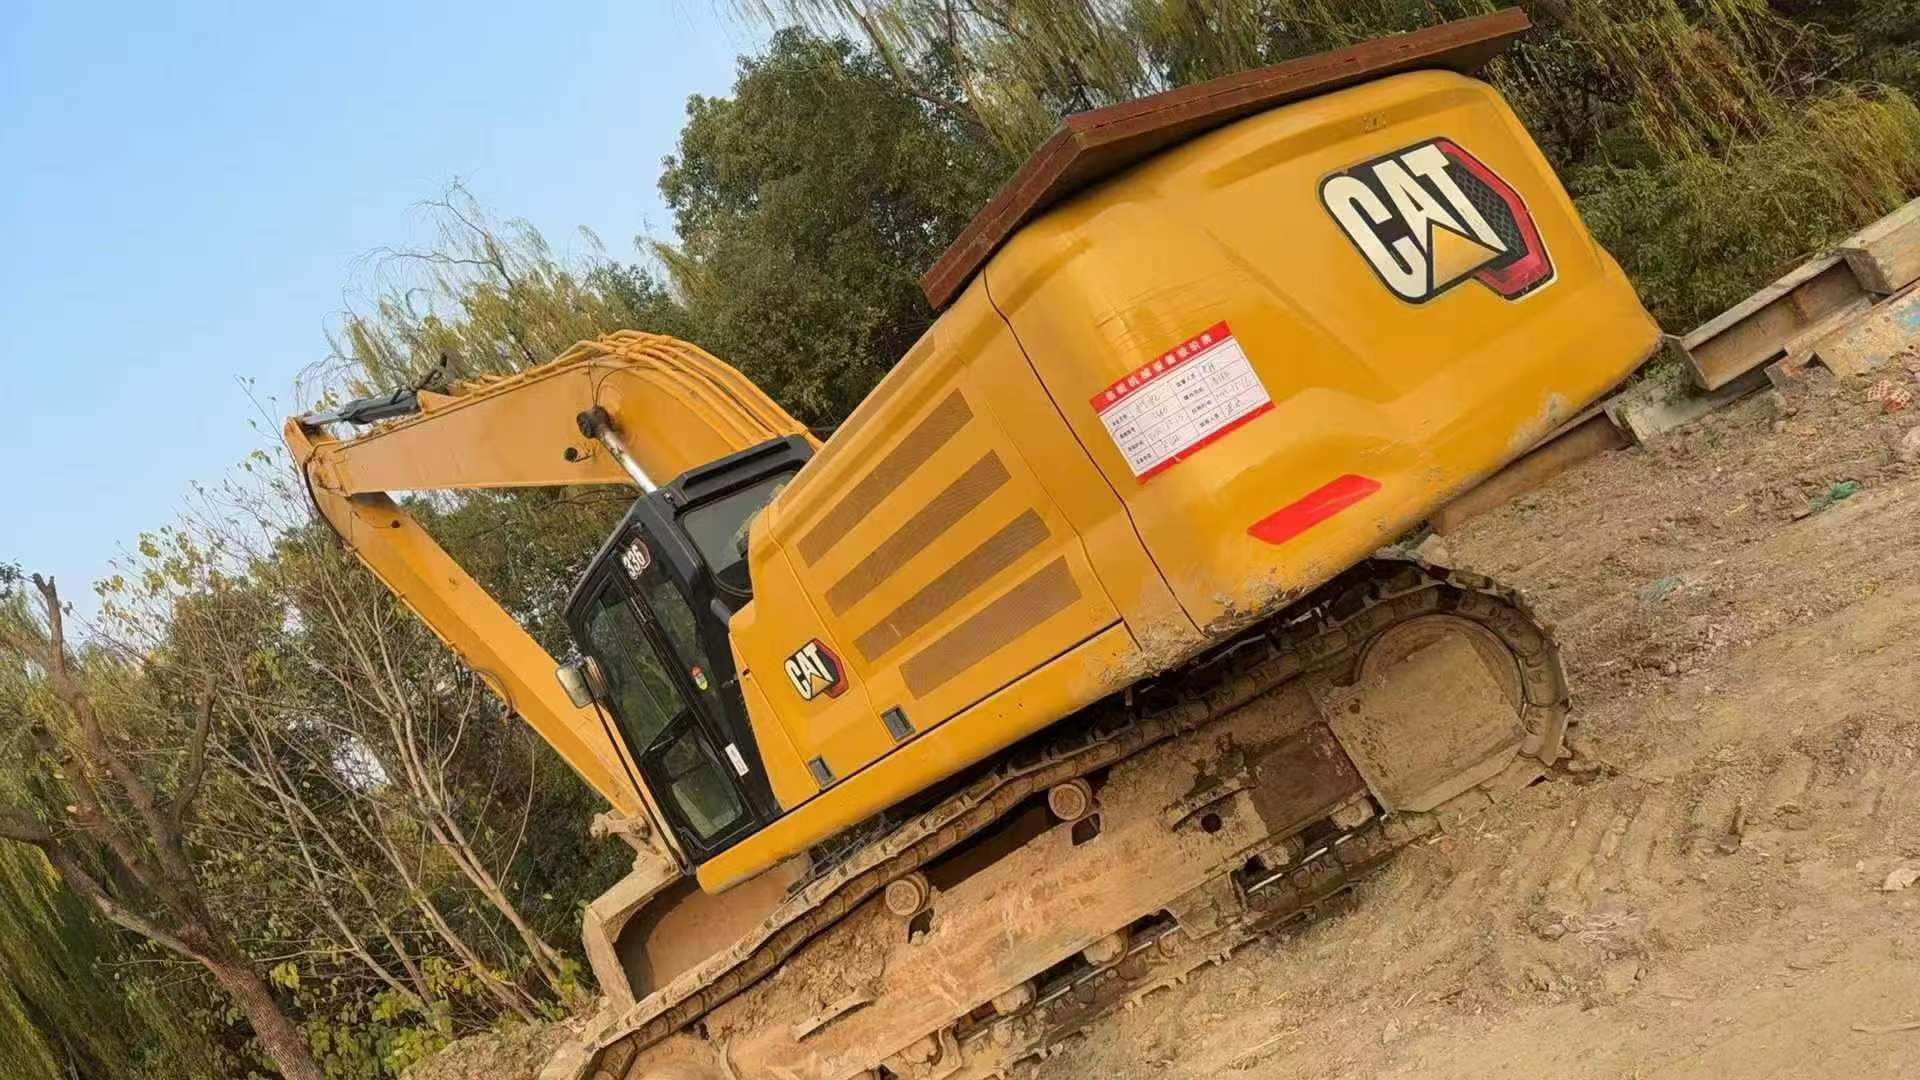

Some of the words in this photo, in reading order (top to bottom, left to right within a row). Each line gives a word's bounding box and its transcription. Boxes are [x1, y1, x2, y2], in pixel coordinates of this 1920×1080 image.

[1324, 144, 1508, 297] CAT
[623, 544, 646, 577] 336
[785, 642, 834, 699] CAT
